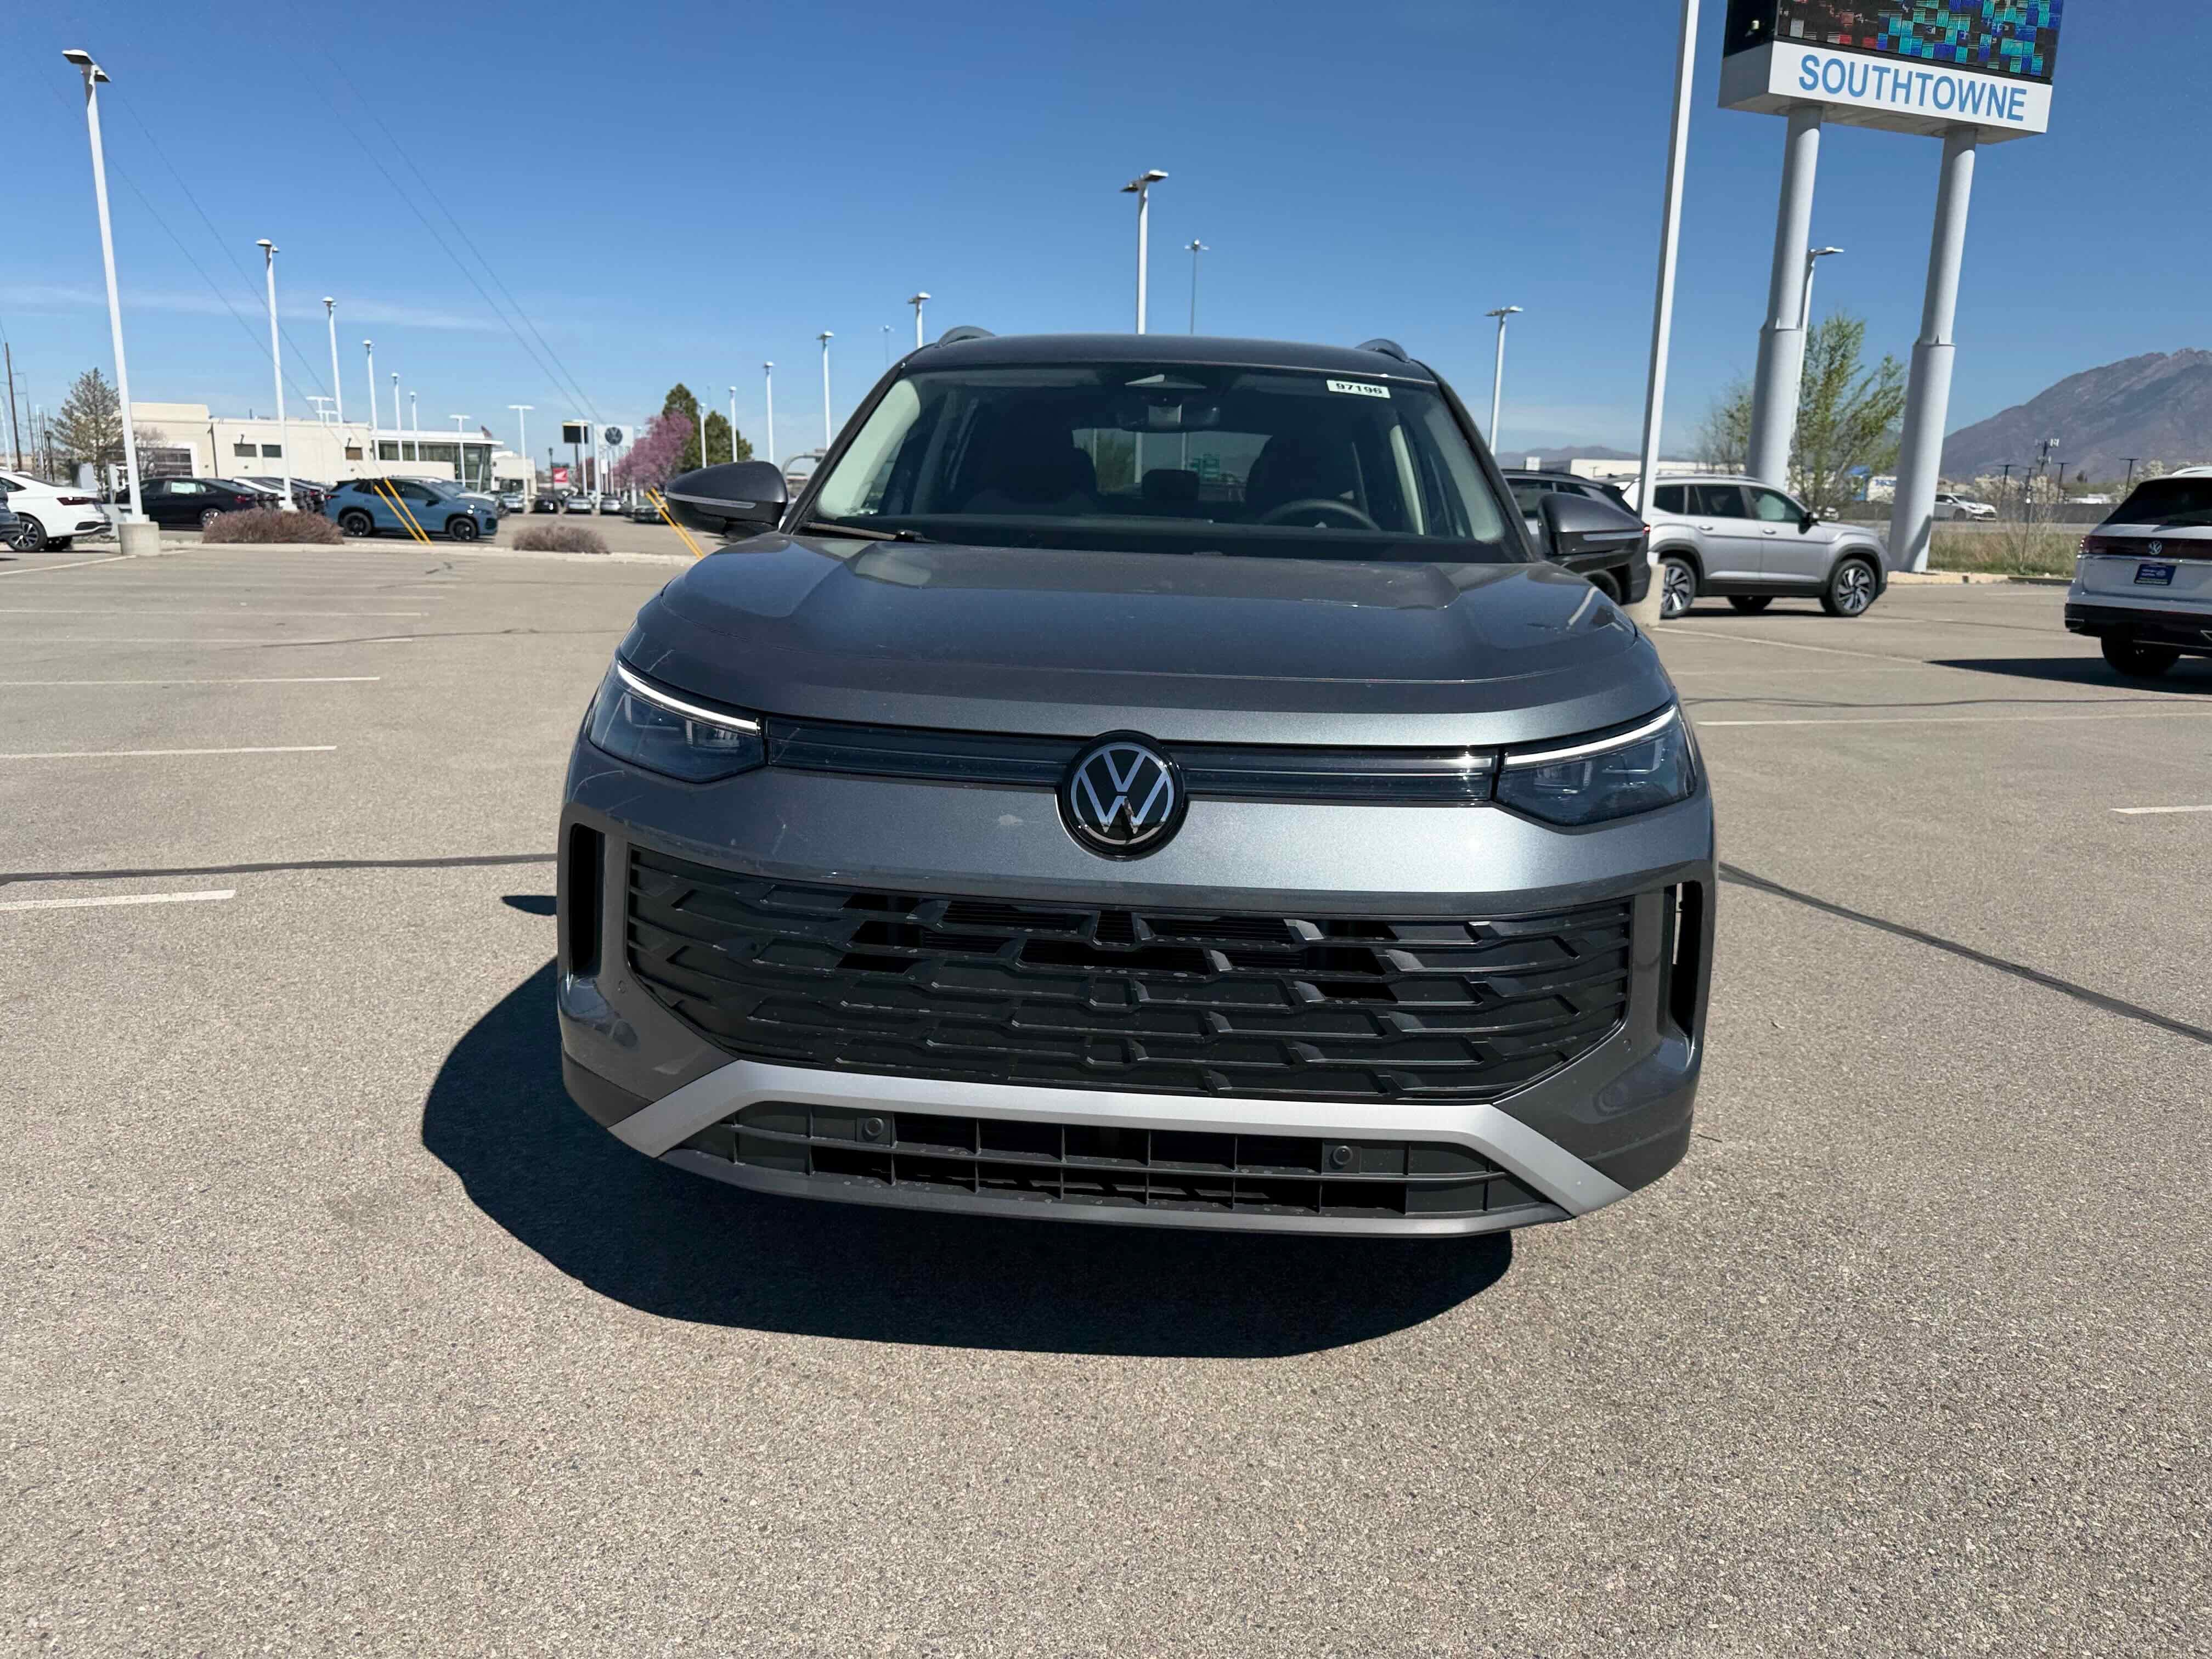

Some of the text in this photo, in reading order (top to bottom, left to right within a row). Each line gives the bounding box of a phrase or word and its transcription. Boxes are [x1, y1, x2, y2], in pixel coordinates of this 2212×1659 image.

[1799, 54, 2028, 122] SOUTHTOWNE
[1335, 382, 1383, 394] 97196
[1071, 741, 1175, 845] VW
